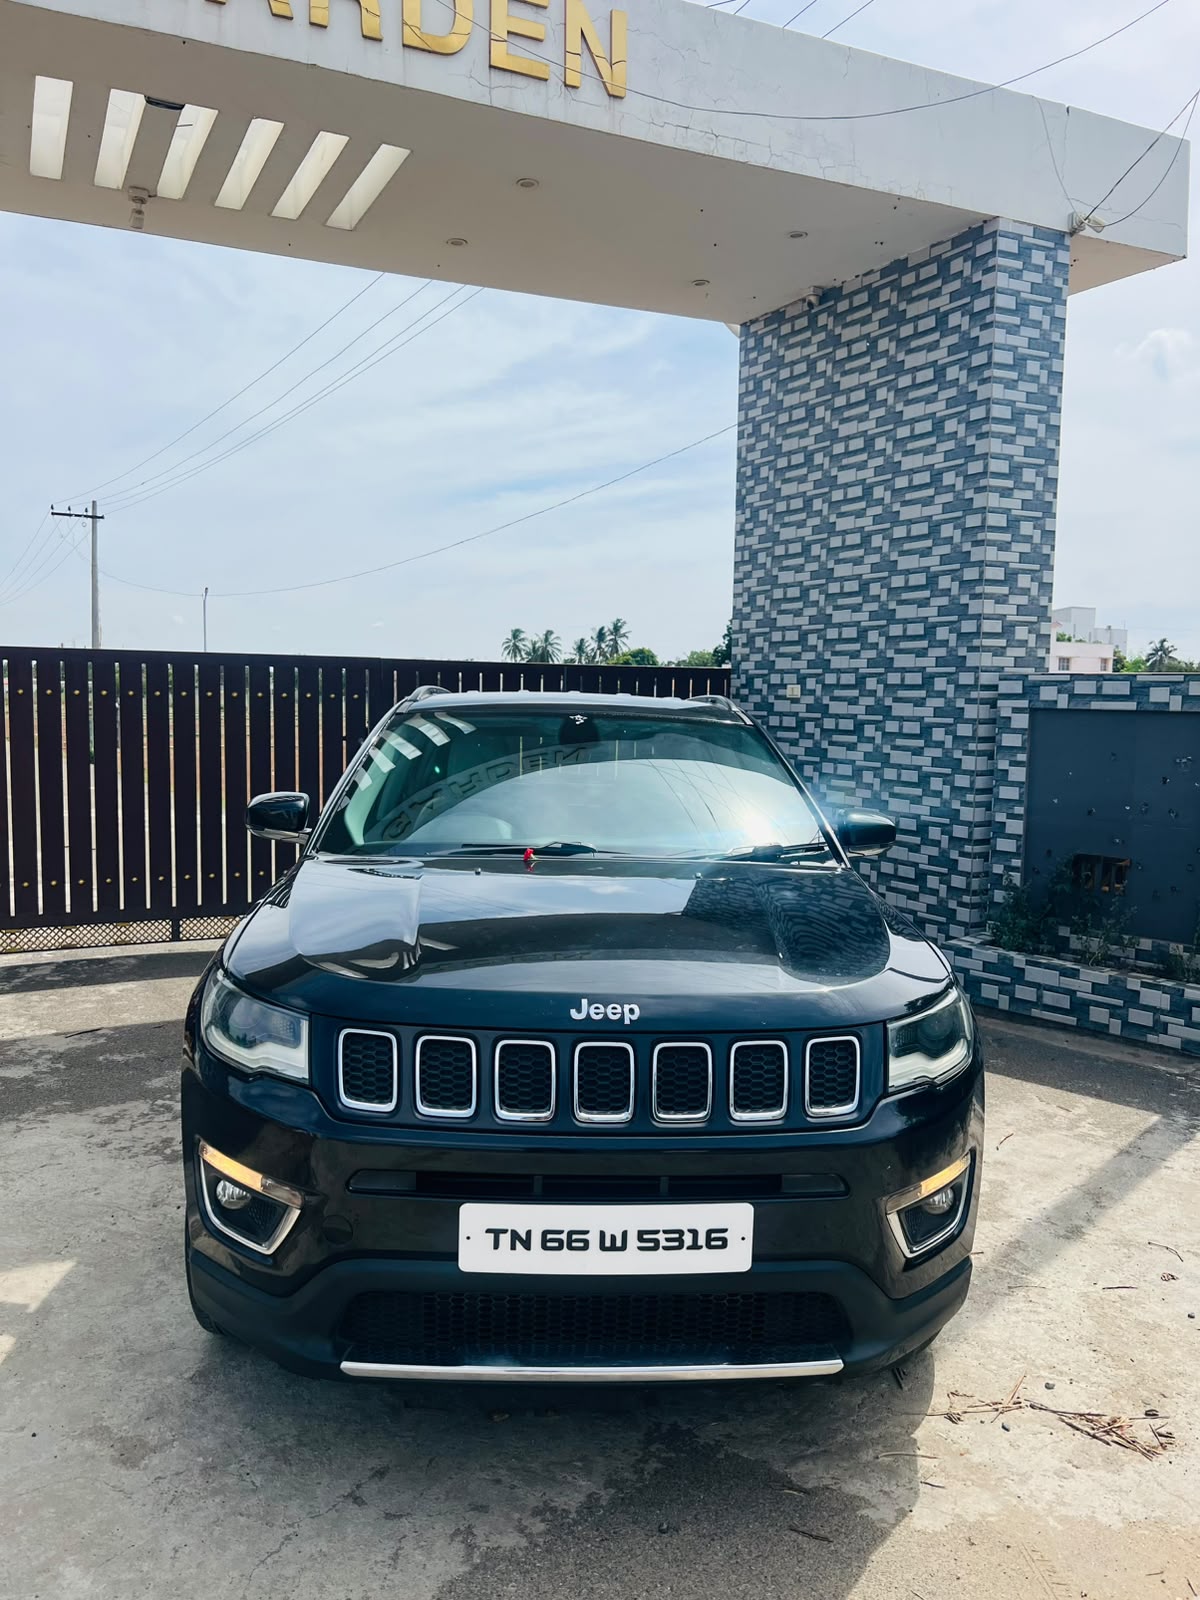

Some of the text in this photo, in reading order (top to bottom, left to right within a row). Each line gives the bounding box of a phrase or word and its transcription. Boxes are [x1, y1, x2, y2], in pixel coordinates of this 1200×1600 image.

[208, 0, 628, 98] DEN
[570, 998, 641, 1025] Jeep
[485, 1228, 729, 1252] TN 66 W 5316
